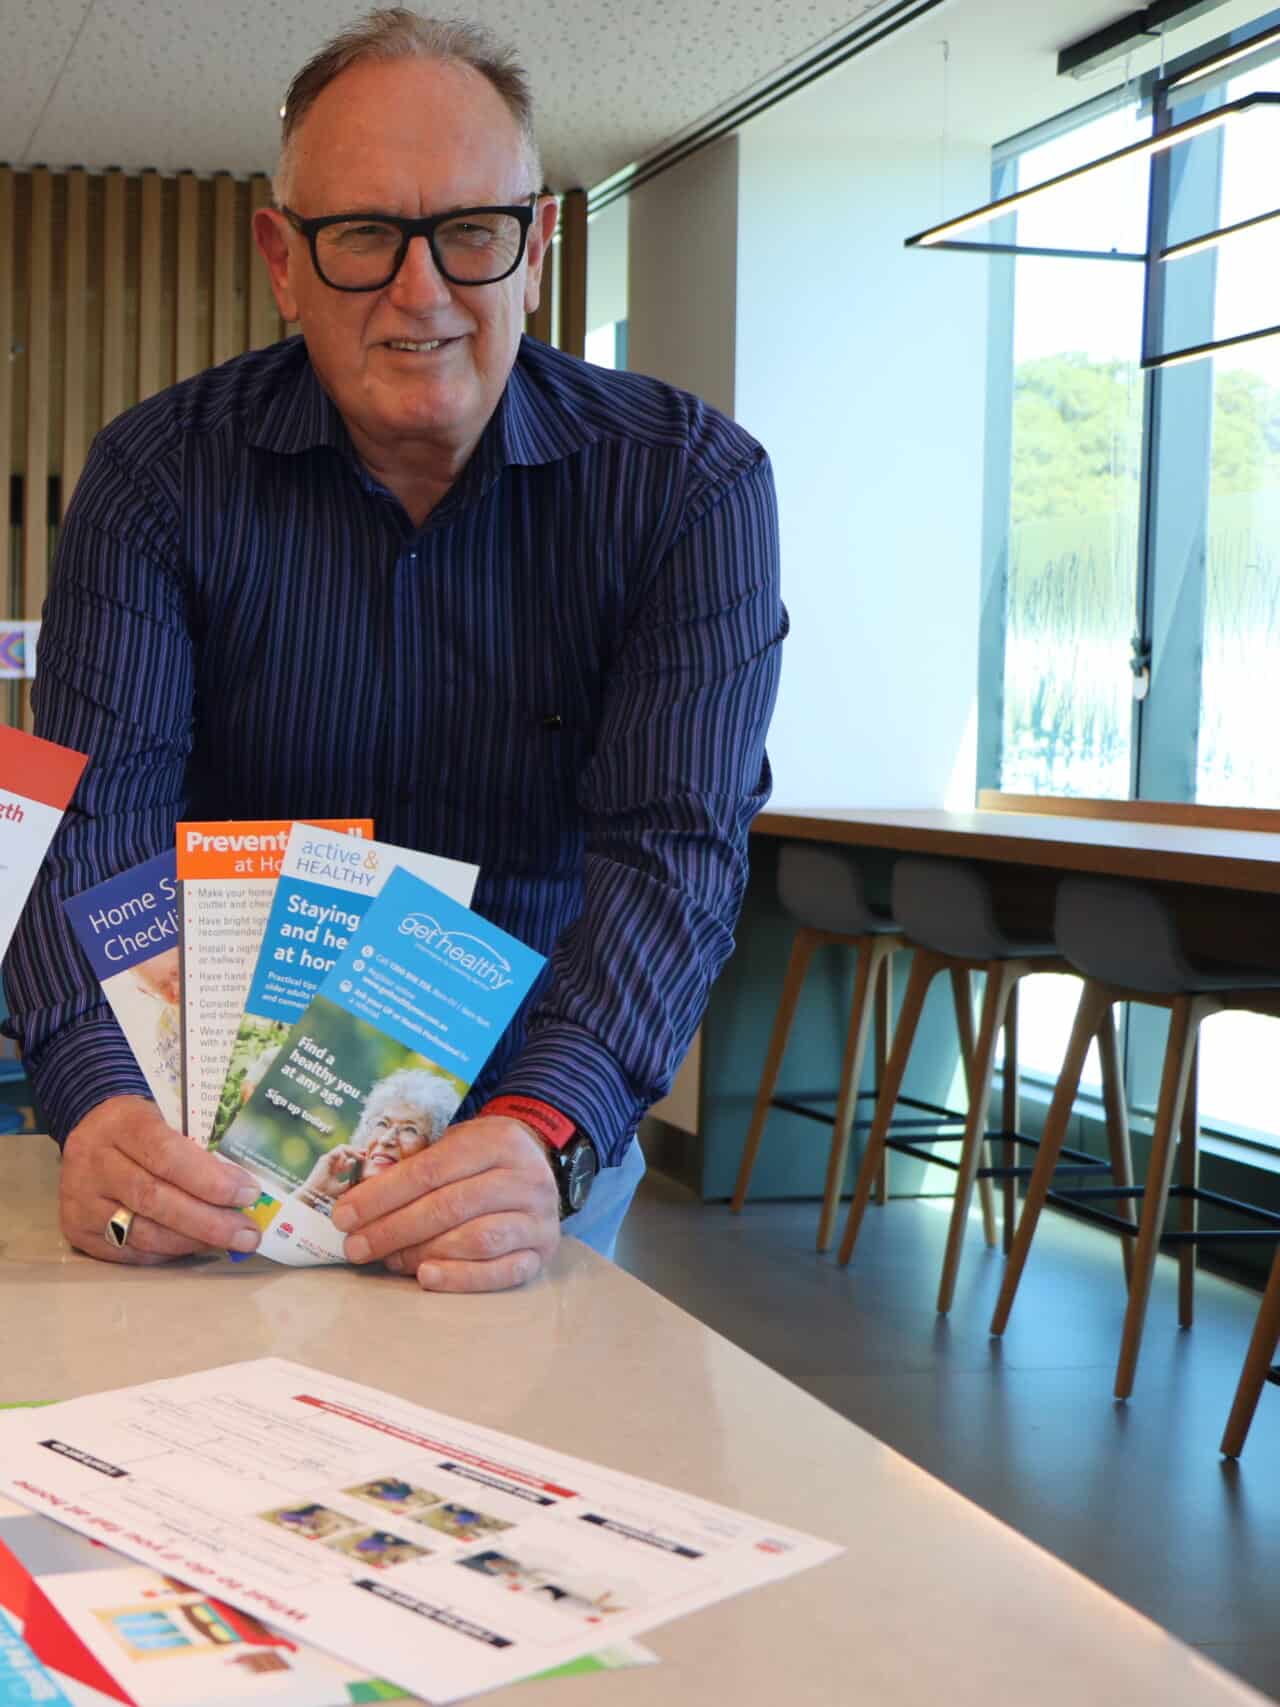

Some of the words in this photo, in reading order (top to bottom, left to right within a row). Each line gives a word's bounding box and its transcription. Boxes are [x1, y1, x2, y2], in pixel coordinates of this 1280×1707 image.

[186, 831, 288, 853] Prevent
[302, 840, 361, 866] active
[362, 850, 379, 870] &
[235, 858, 256, 873] at
[296, 858, 376, 888] HEALTHY
[89, 892, 157, 934] Home
[160, 878, 178, 900] S
[287, 894, 361, 932] Staying
[280, 923, 320, 943] and
[323, 928, 349, 950] he
[273, 946, 295, 964] at
[398, 917, 439, 944] get
[437, 935, 513, 990] healthy
[298, 1036, 328, 1059] Find
[323, 1052, 337, 1066] a
[281, 1065, 297, 1079] at
[296, 1074, 320, 1093] any
[320, 1088, 343, 1106] age
[289, 1048, 337, 1086] healthy
[334, 1079, 360, 1099] you
[265, 1088, 288, 1106] Sign
[287, 1102, 301, 1115] up
